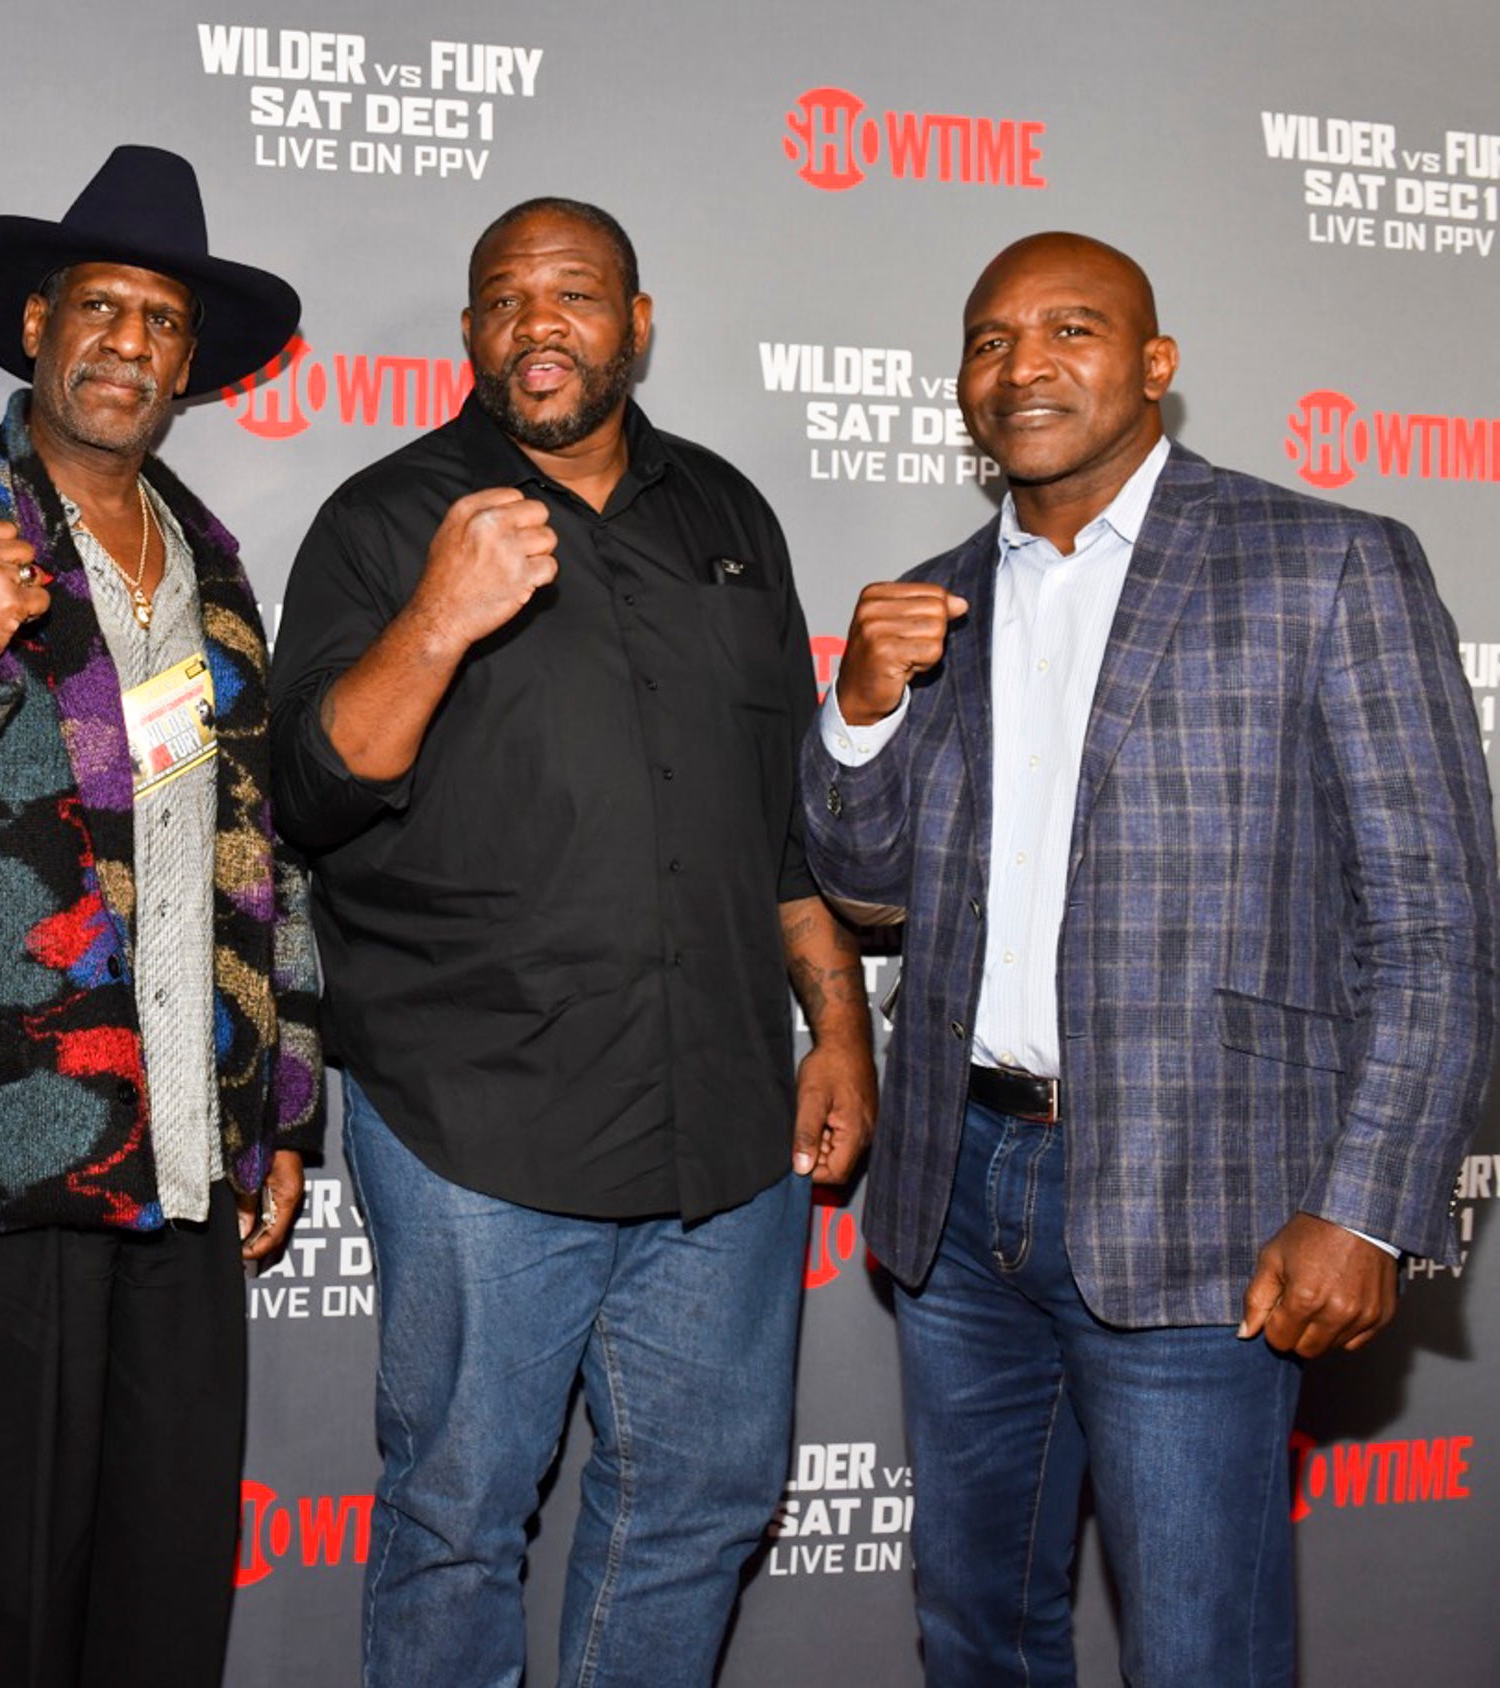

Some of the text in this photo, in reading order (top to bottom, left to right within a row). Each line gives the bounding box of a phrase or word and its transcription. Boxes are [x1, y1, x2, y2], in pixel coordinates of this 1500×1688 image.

[198, 24, 365, 84] WILDER
[431, 41, 543, 96] FURY
[251, 87, 492, 140] SAT DEC 1
[782, 85, 1048, 193] SHOWTIME
[256, 135, 488, 179] LIVE ON PPV
[1262, 112, 1396, 171] WILDER
[1305, 166, 1496, 220] SAT DEC 1
[1310, 214, 1494, 256] LIVE ON PPV
[222, 336, 475, 441] HOWTIM
[759, 343, 912, 397] WILDER
[807, 402, 900, 442] SAT
[811, 449, 886, 481] LIVE
[898, 453, 944, 484] ON
[323, 1285, 373, 1316] ON
[790, 1443, 875, 1490] DER
[1292, 1435, 1474, 1522] OWTIME
[770, 1544, 844, 1575] LIVE
[855, 1542, 901, 1571] ON
